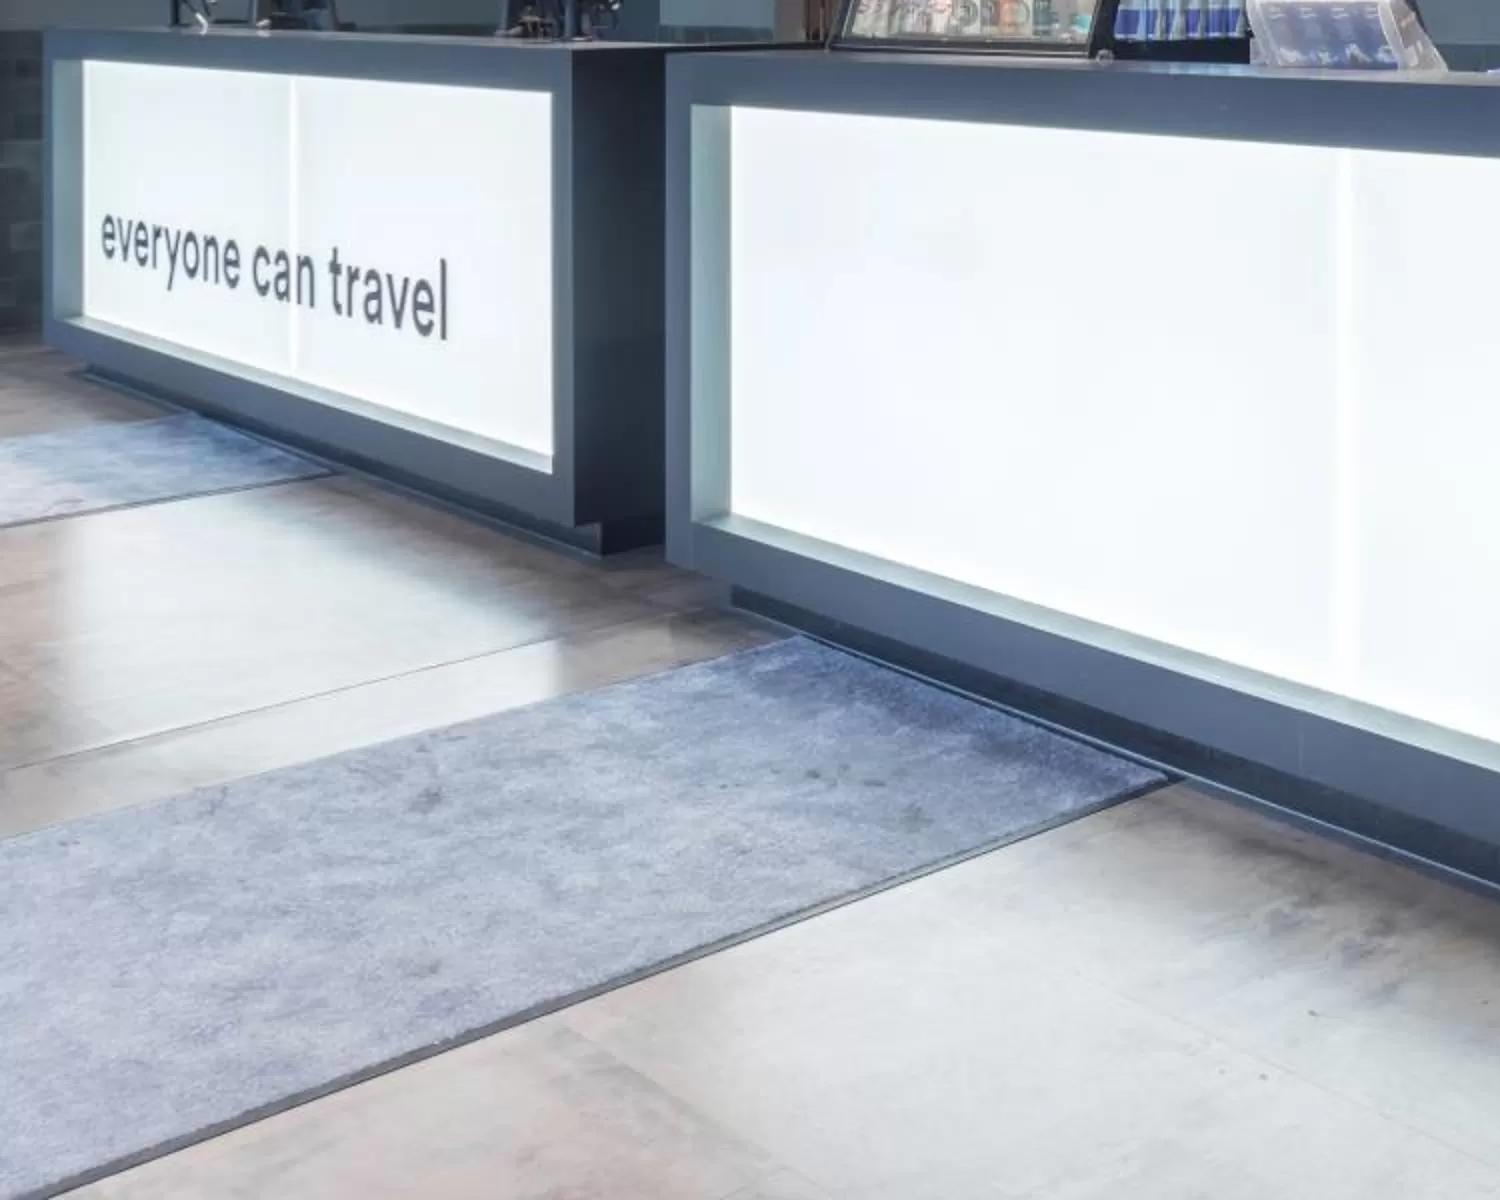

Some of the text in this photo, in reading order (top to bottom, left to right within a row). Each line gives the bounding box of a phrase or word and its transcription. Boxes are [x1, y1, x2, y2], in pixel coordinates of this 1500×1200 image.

[101, 213, 447, 341] everyone can travel
